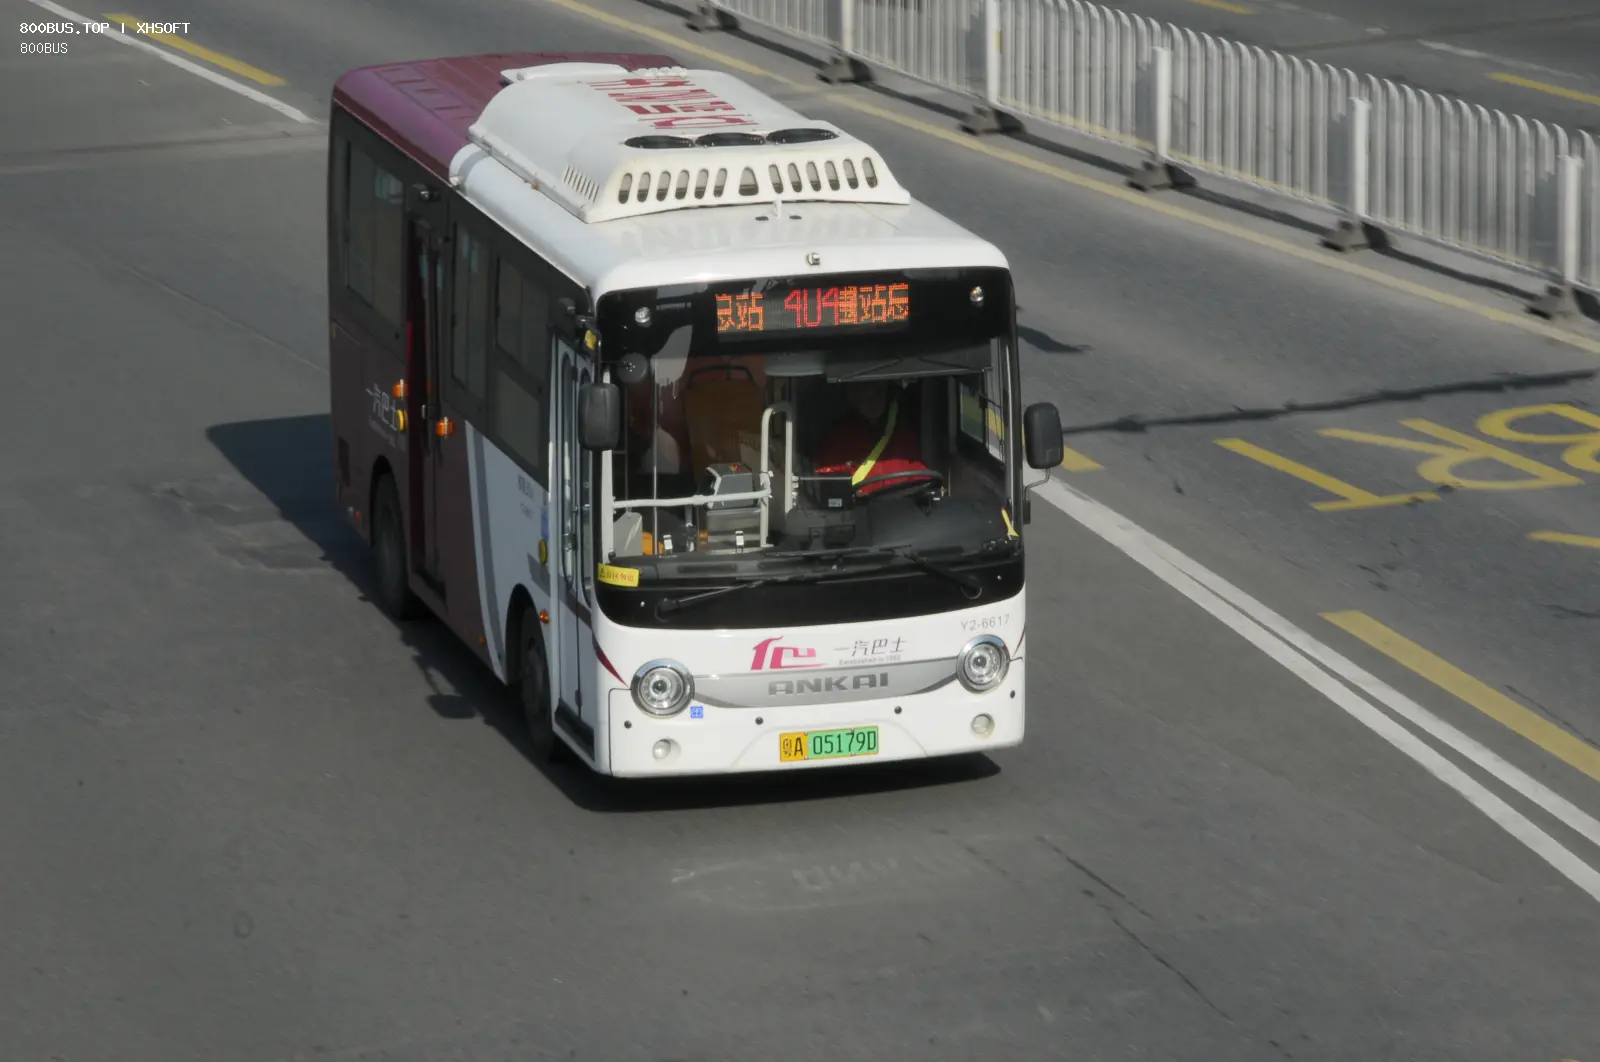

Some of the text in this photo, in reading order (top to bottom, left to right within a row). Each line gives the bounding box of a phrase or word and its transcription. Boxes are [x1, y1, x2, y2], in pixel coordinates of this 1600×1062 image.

[961, 613, 1010, 631] Y2-6617
[833, 636, 906, 656] 一汽巴士
[768, 672, 889, 695] ANKAI
